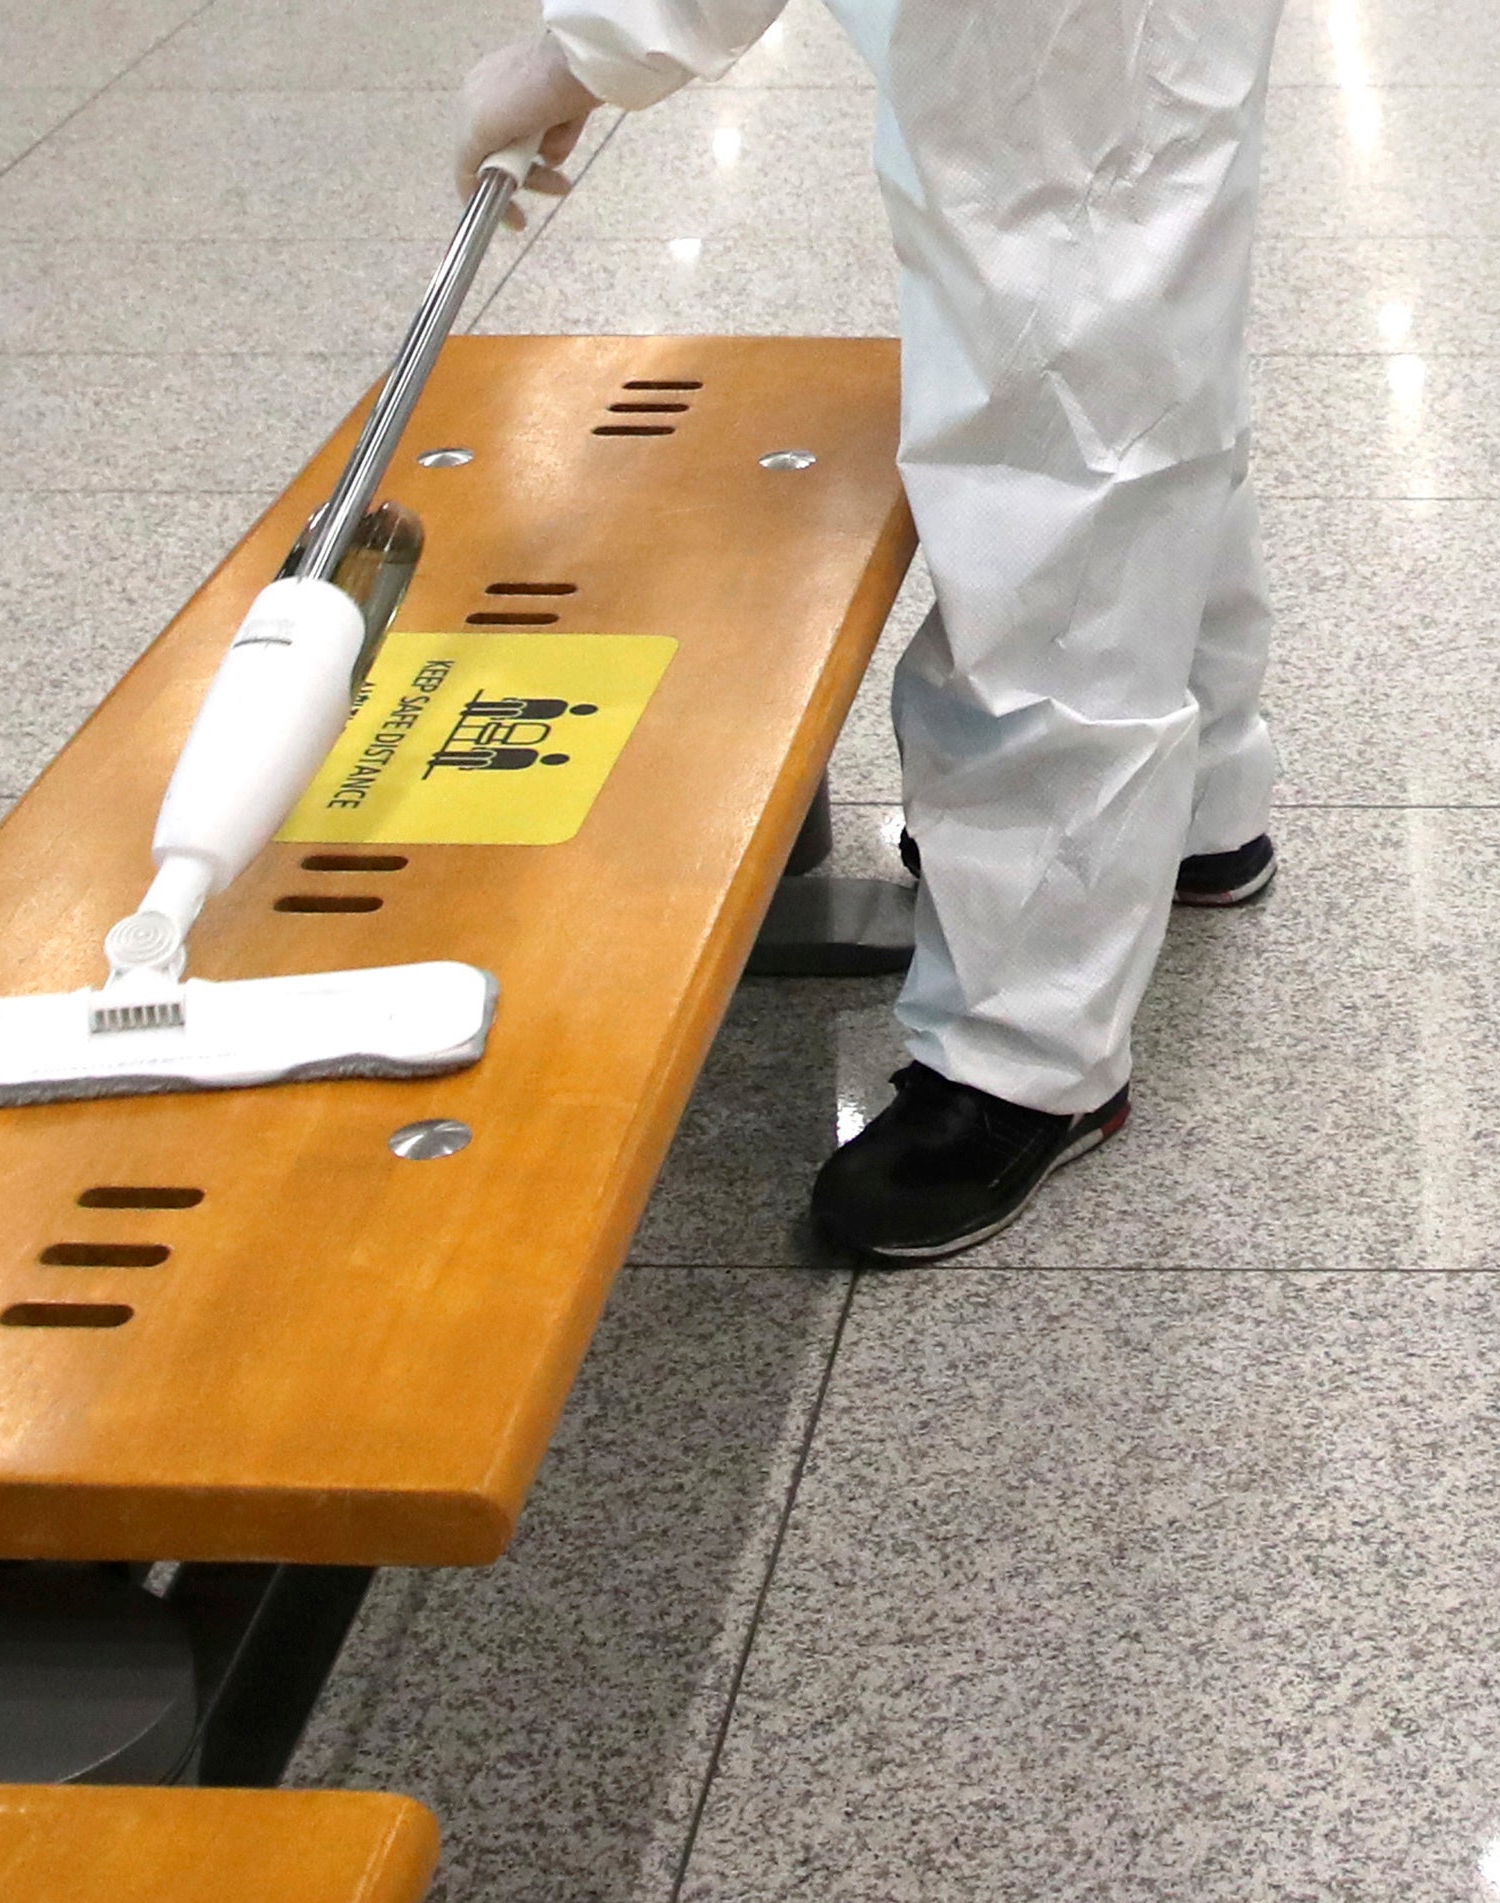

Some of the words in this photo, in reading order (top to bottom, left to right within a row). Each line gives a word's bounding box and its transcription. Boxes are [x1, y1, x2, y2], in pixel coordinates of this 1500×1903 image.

[411, 659, 456, 694] KEEP
[382, 695, 431, 730] SAFE
[326, 733, 407, 810] DISTANCE
